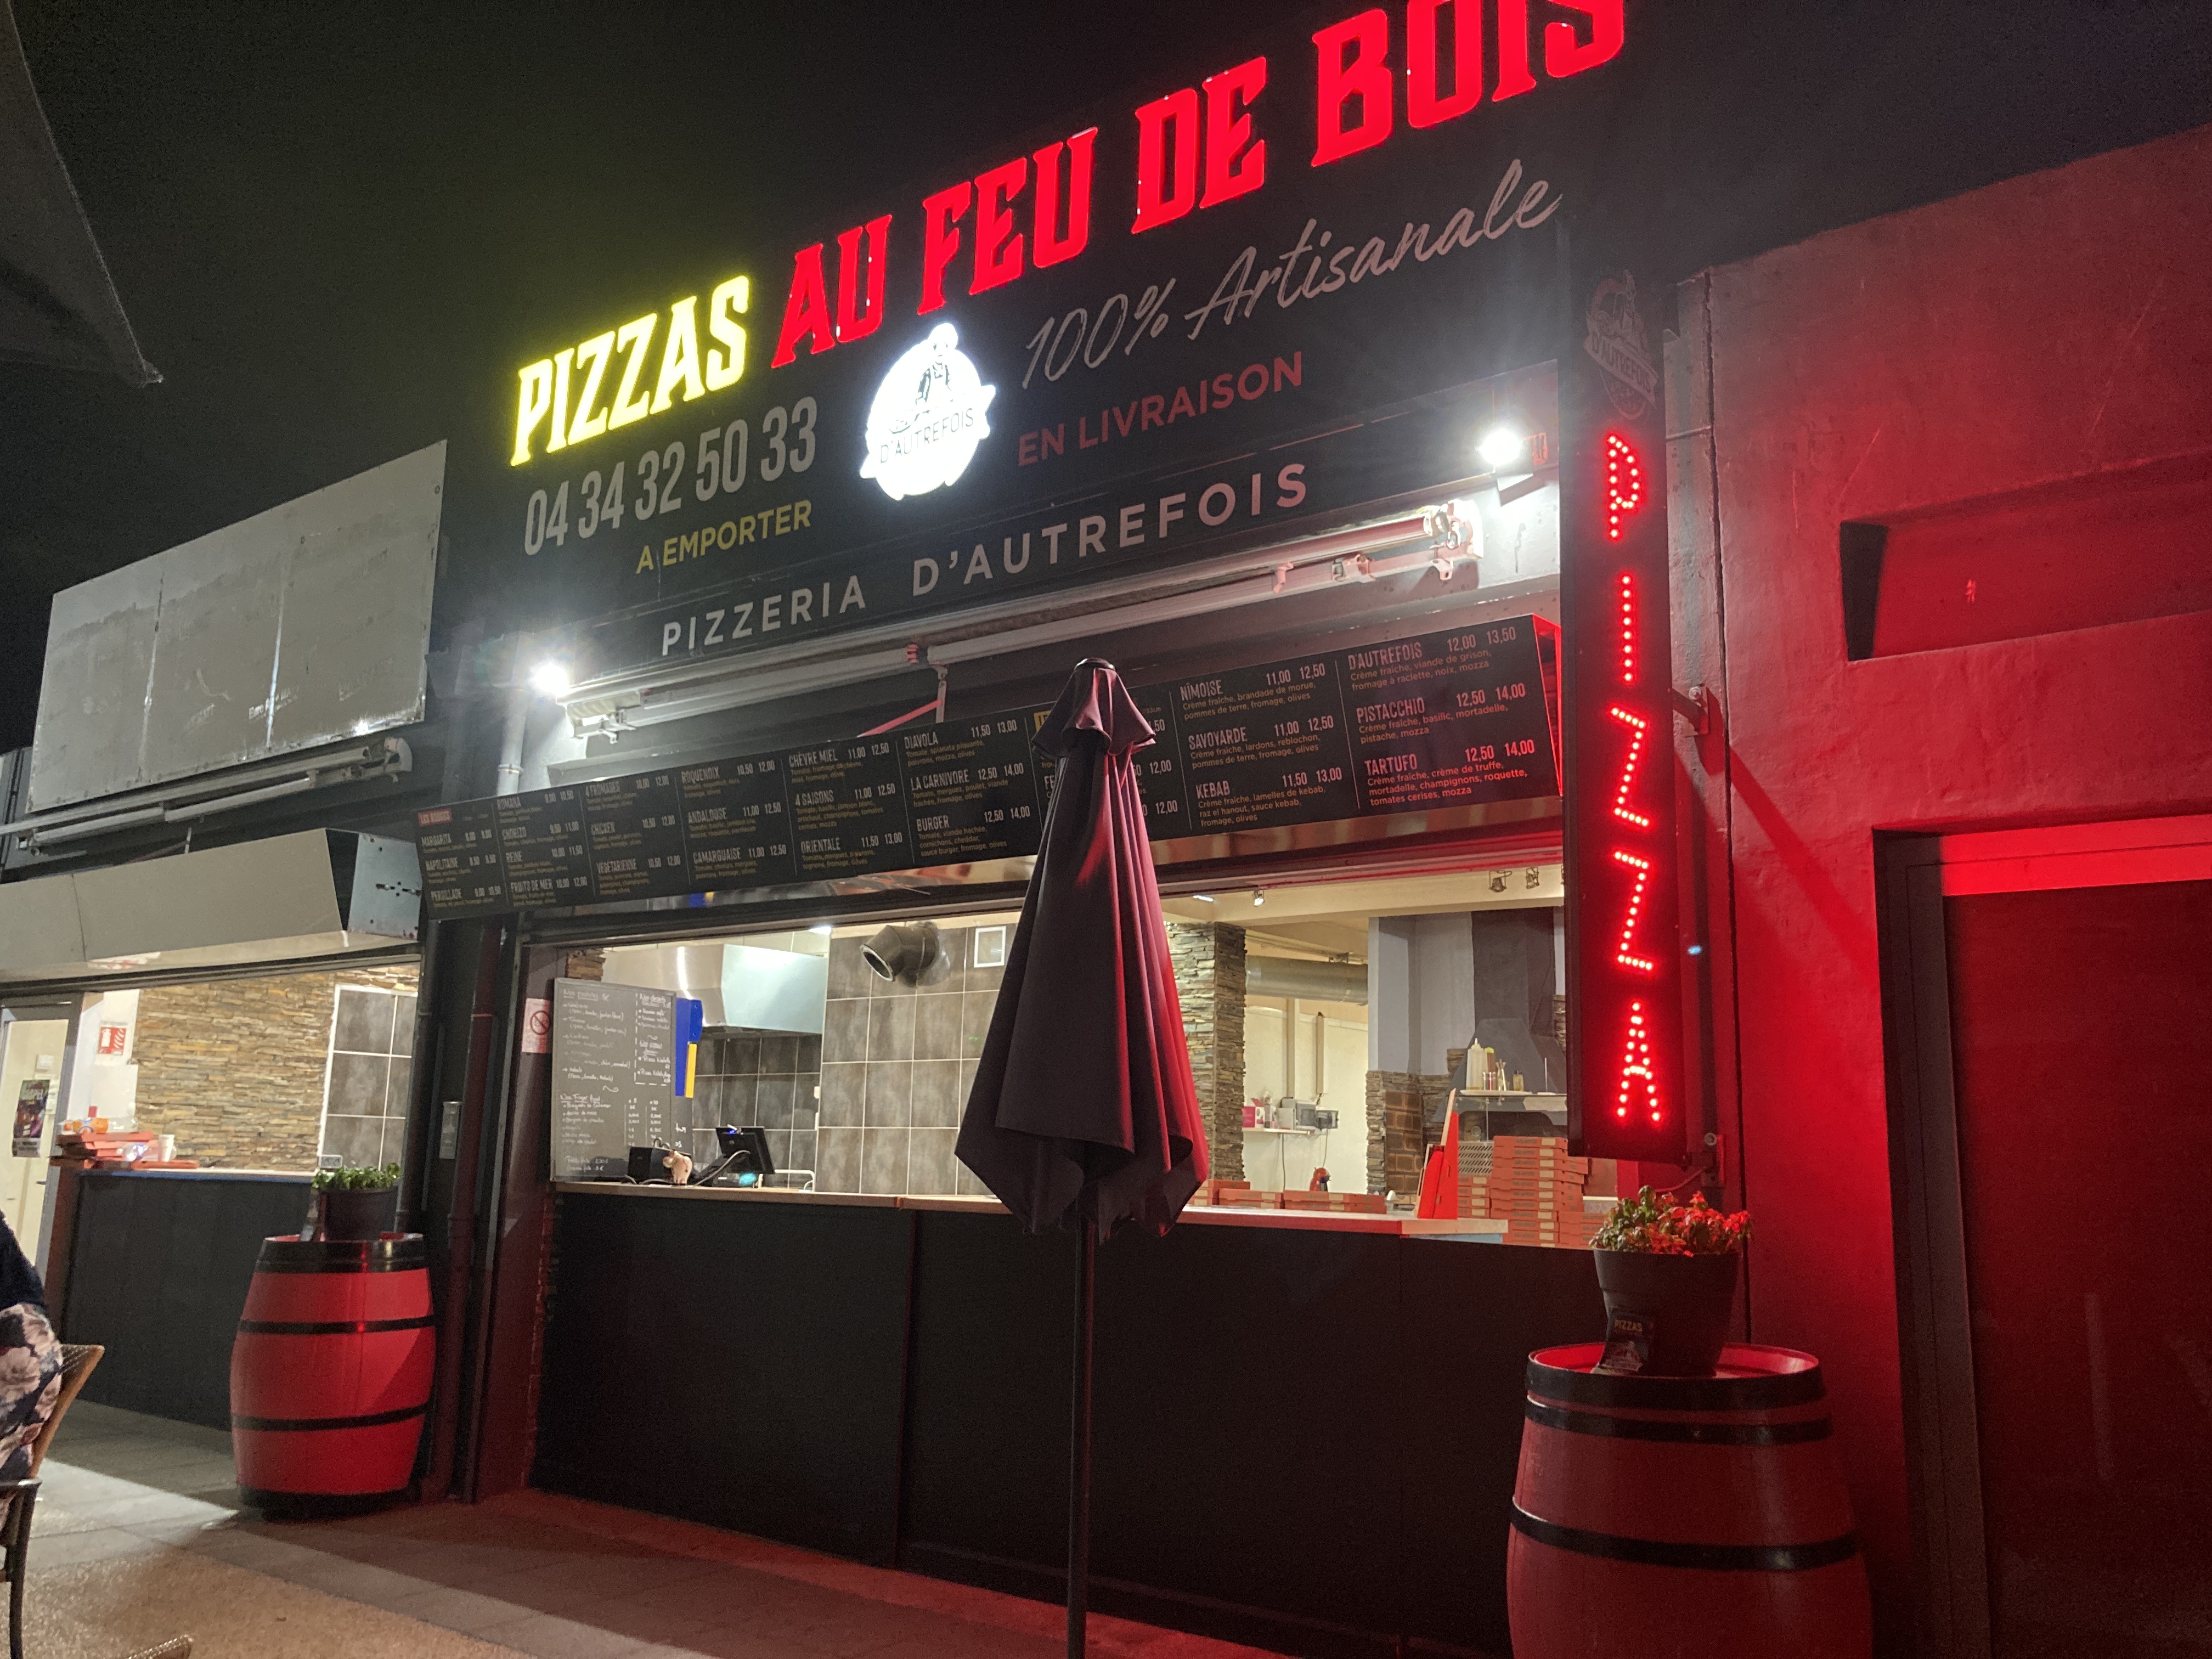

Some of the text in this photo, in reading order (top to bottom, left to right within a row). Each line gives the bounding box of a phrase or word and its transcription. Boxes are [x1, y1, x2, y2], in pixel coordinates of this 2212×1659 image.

[511, 275, 749, 466] PIZZAS
[771, 215, 892, 368] AU
[917, 127, 1097, 315] FEU
[1131, 57, 1266, 233] DE
[1023, 159, 1562, 389] 100% Artisanale
[1018, 351, 1302, 466] EN LIVRAISON
[881, 408, 974, 464] D'AUTREFOIS
[524, 397, 817, 555] 04 34 32 50 33
[636, 500, 811, 573] A EMPORTER
[662, 464, 1307, 656] PIZZERIA D'AUTREFOIS
[1348, 626, 1516, 670] D'AUTREFOIS 12,00 13,50
[1352, 661, 1489, 691] fromage à raclette, noix, mozza
[1414, 658, 1443, 669] viande
[1180, 663, 1325, 701] NÎMOISE 11,00 12,50
[1238, 688, 1273, 701] brandade
[1184, 710, 1215, 720] pommes
[1288, 693, 1311, 702] olives
[1356, 682, 1526, 724] PISTACCHIO 12,50 14,00
[1456, 703, 1508, 718] mortadelle,
[904, 720, 1017, 749] DIAVOLA 11,50 13,00
[1188, 715, 1334, 750] SAVOYARDE 11,00 12,50
[1245, 741, 1276, 750] lardons,
[1278, 735, 1321, 746] reblochon,
[1401, 727, 1429, 737] mozza
[819, 748, 838, 763] MIEL
[848, 747, 866, 759] 11,00
[872, 742, 889, 756] 12,50
[1192, 759, 1223, 770] pommes
[1296, 743, 1319, 752] olives
[1364, 739, 1535, 776] TARTUFO 12,50 14,00
[910, 763, 1024, 791] LA CARNIVORE 12,50 14,00
[1149, 760, 1172, 775] 12,00
[1462, 765, 1473, 774] de
[1606, 435, 1662, 1120] PIZZA
[795, 783, 895, 806] 4 SAISONS 11,00 12,50
[1196, 768, 1342, 799] KEBAB 11,50 13,00
[1253, 791, 1285, 800] lamelles
[1299, 786, 1326, 795] kebab,
[1369, 769, 1527, 795] mortadelle, champignons, roquette,
[1155, 800, 1178, 814] 12,00
[1251, 803, 1273, 811] sauce
[1370, 787, 1471, 806] tomates cerises, mozza
[688, 808, 727, 824] ANDALOUSE
[917, 806, 1030, 831] BURGER 12,50 14,00
[1201, 814, 1257, 827] fromage, olives
[693, 848, 742, 864] CAMARGUAISE
[770, 844, 787, 856] 12,50
[801, 832, 902, 853] ORIENTALE 11,50 13,00
[531, 879, 538, 890] DE
